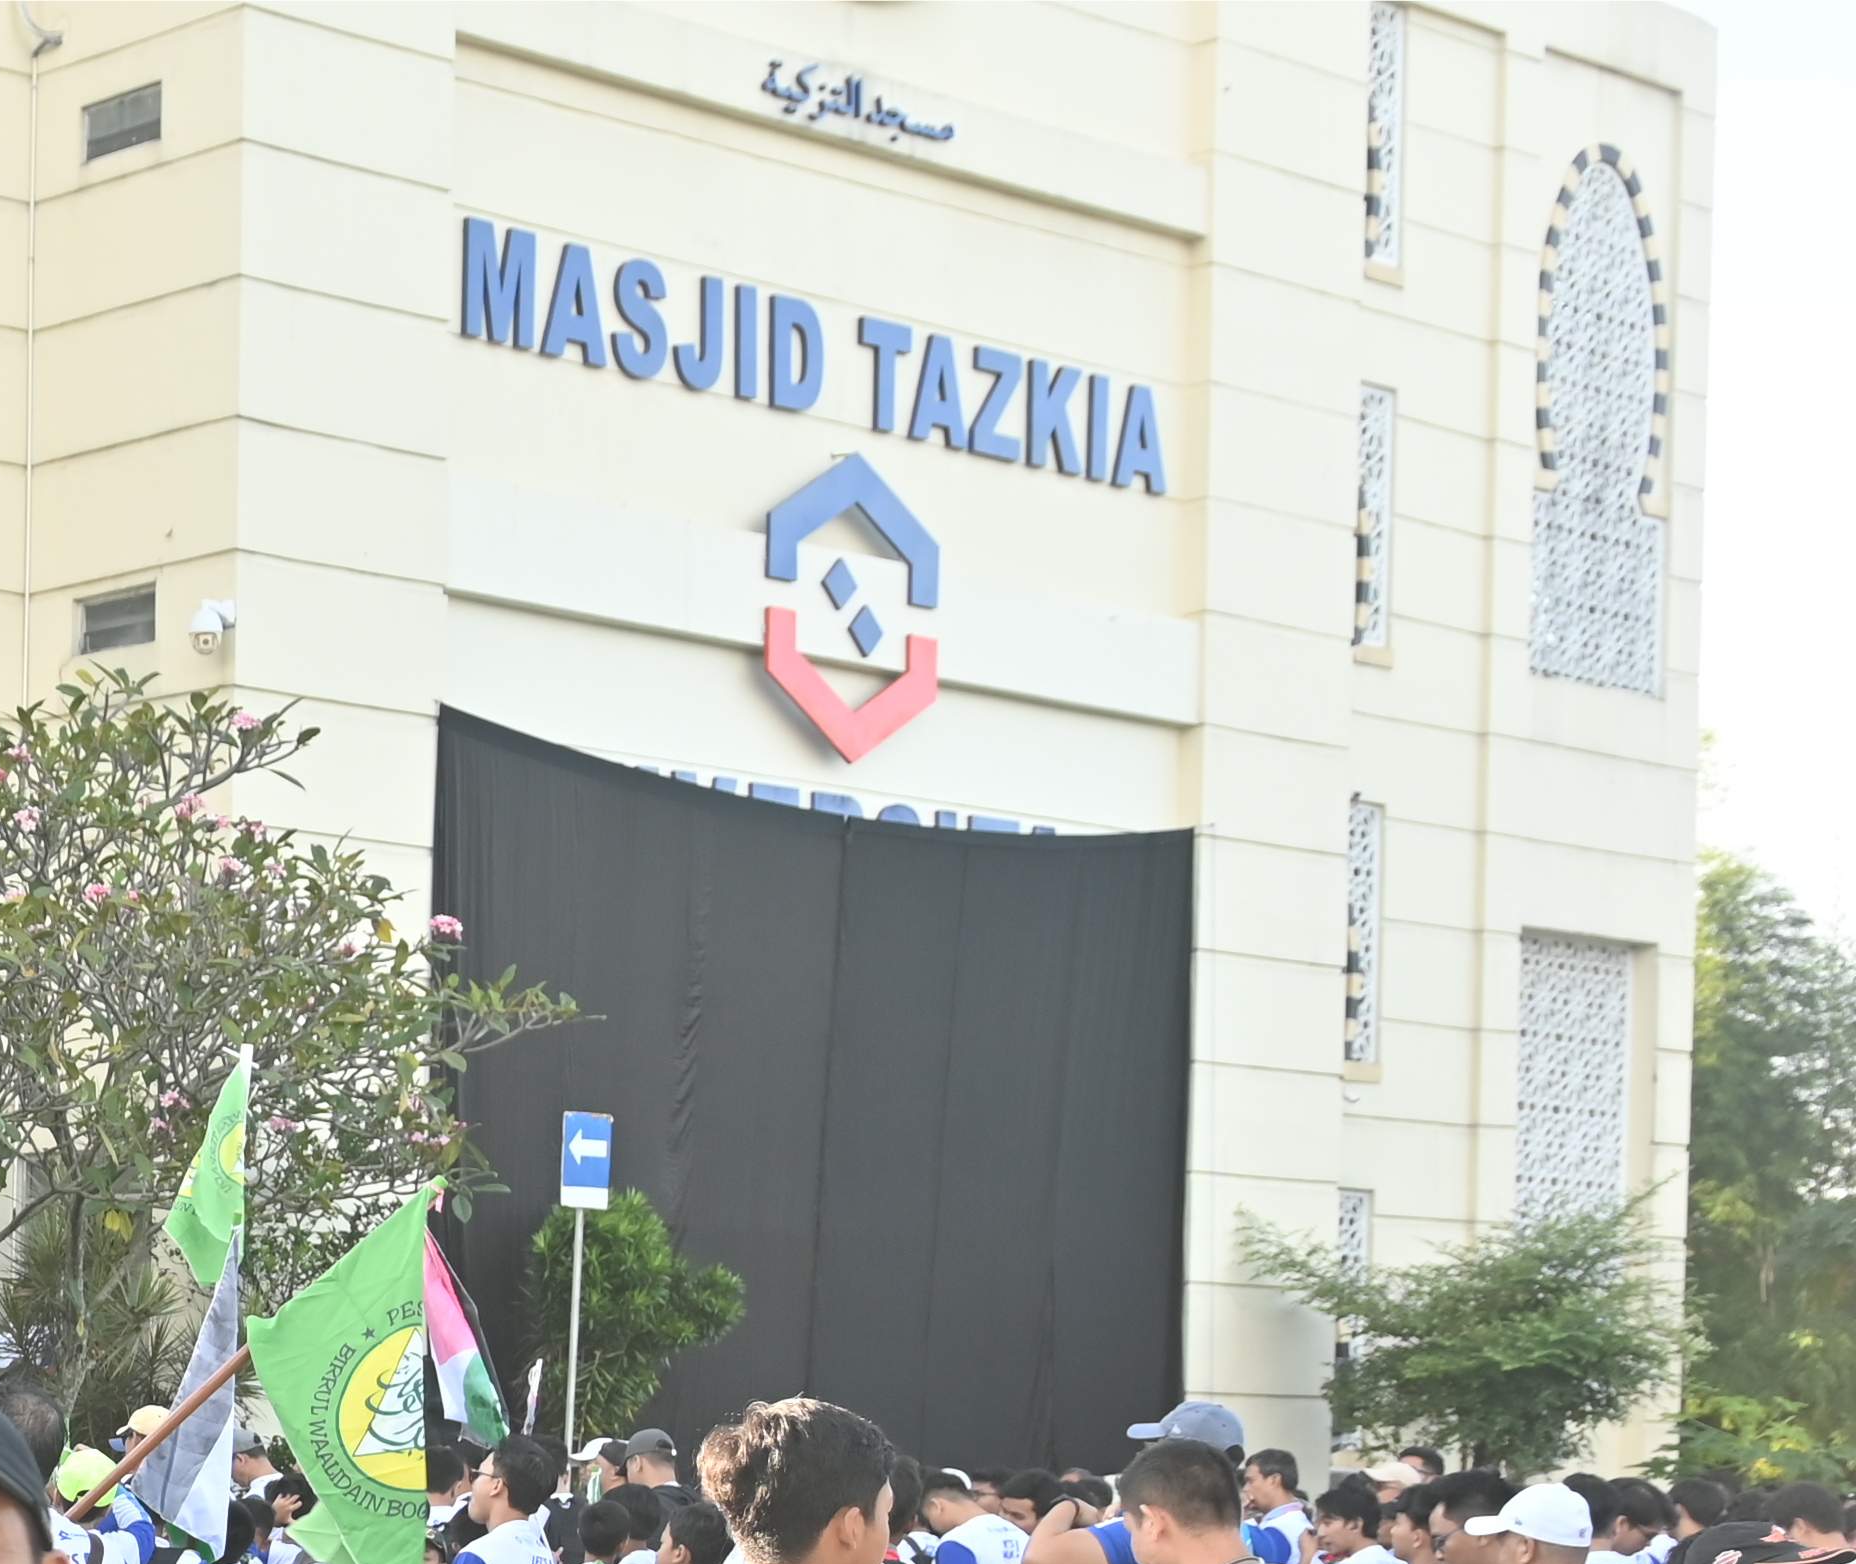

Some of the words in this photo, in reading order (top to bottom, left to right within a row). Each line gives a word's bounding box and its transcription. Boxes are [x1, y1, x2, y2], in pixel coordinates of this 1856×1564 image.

[760, 58, 863, 122] التزكية
[864, 94, 955, 142] مسجد
[460, 215, 826, 415] MASJID
[857, 314, 1168, 496] TAZKIA
[309, 1418, 386, 1513] WAALIDAIN
